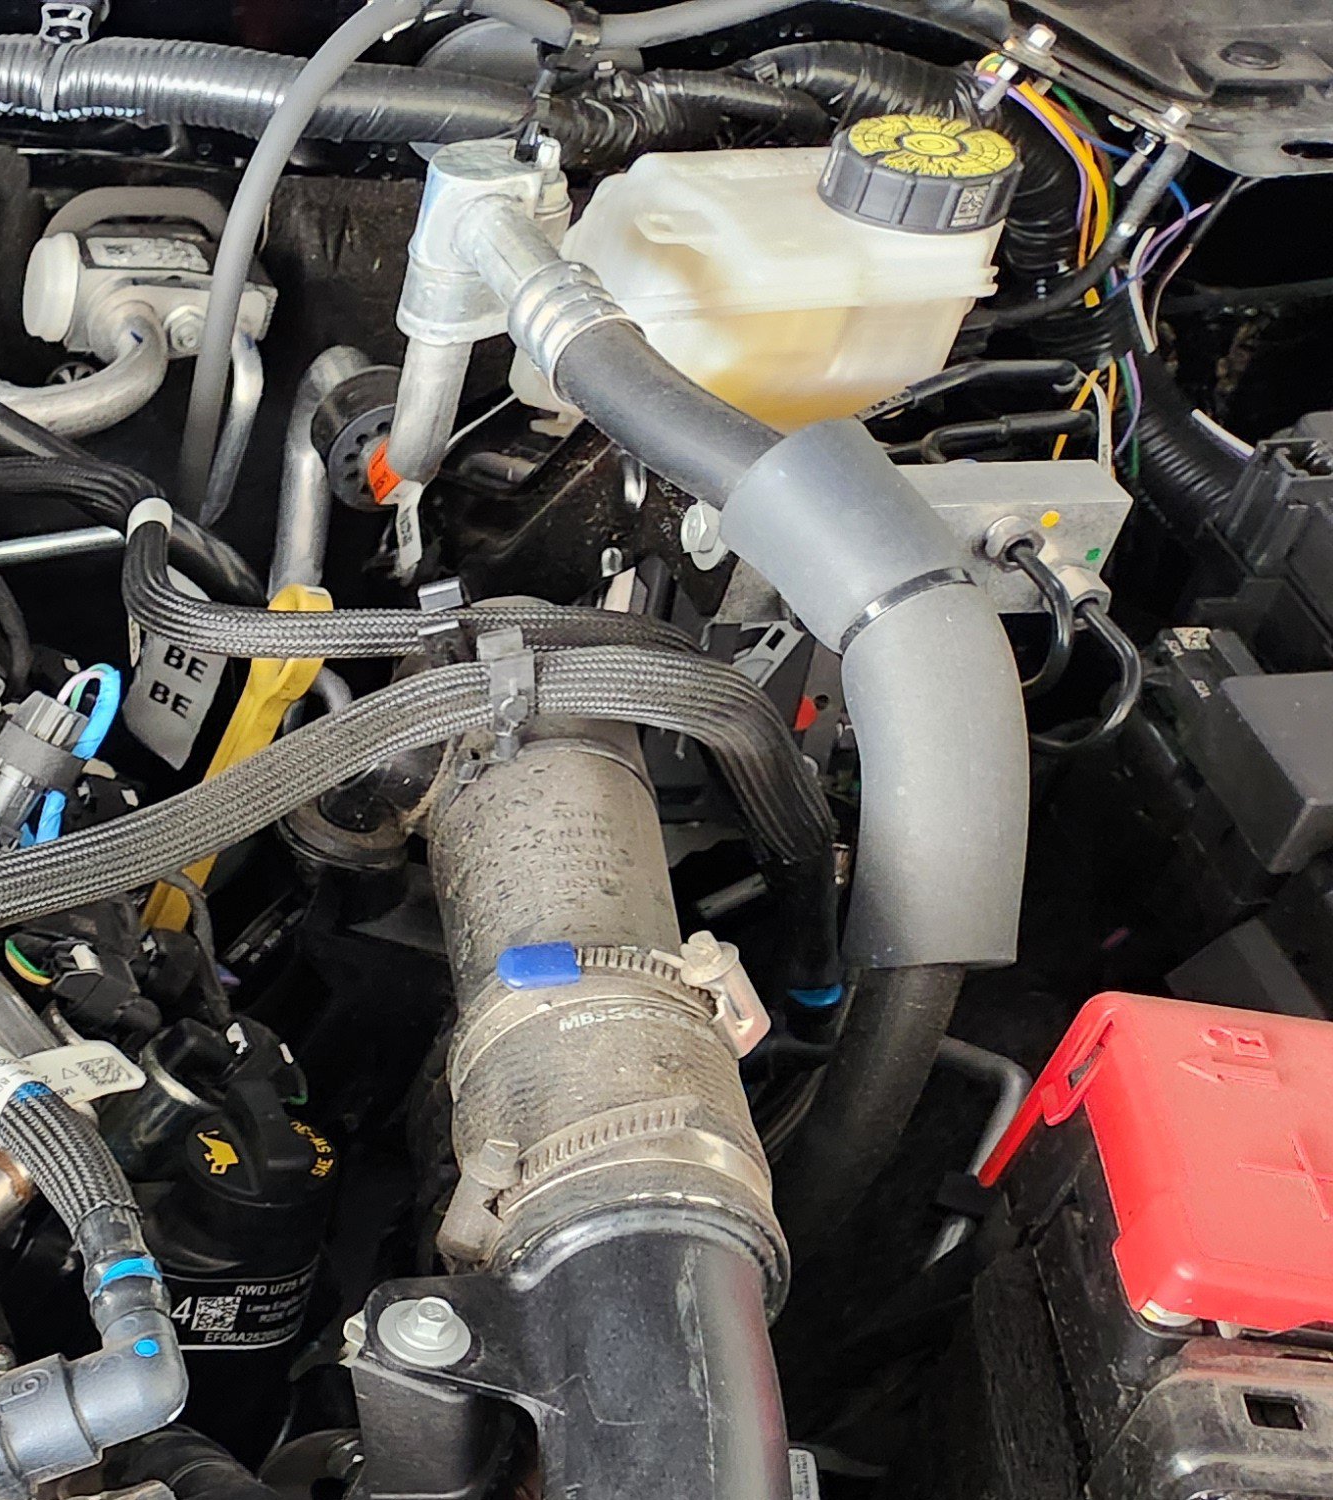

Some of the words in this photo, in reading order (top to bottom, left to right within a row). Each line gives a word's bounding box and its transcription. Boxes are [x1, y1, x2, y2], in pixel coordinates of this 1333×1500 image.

[164, 645, 209, 684] BE
[149, 680, 193, 719] BE
[310, 1157, 334, 1177] SAE
[234, 1285, 267, 1296] RWD
